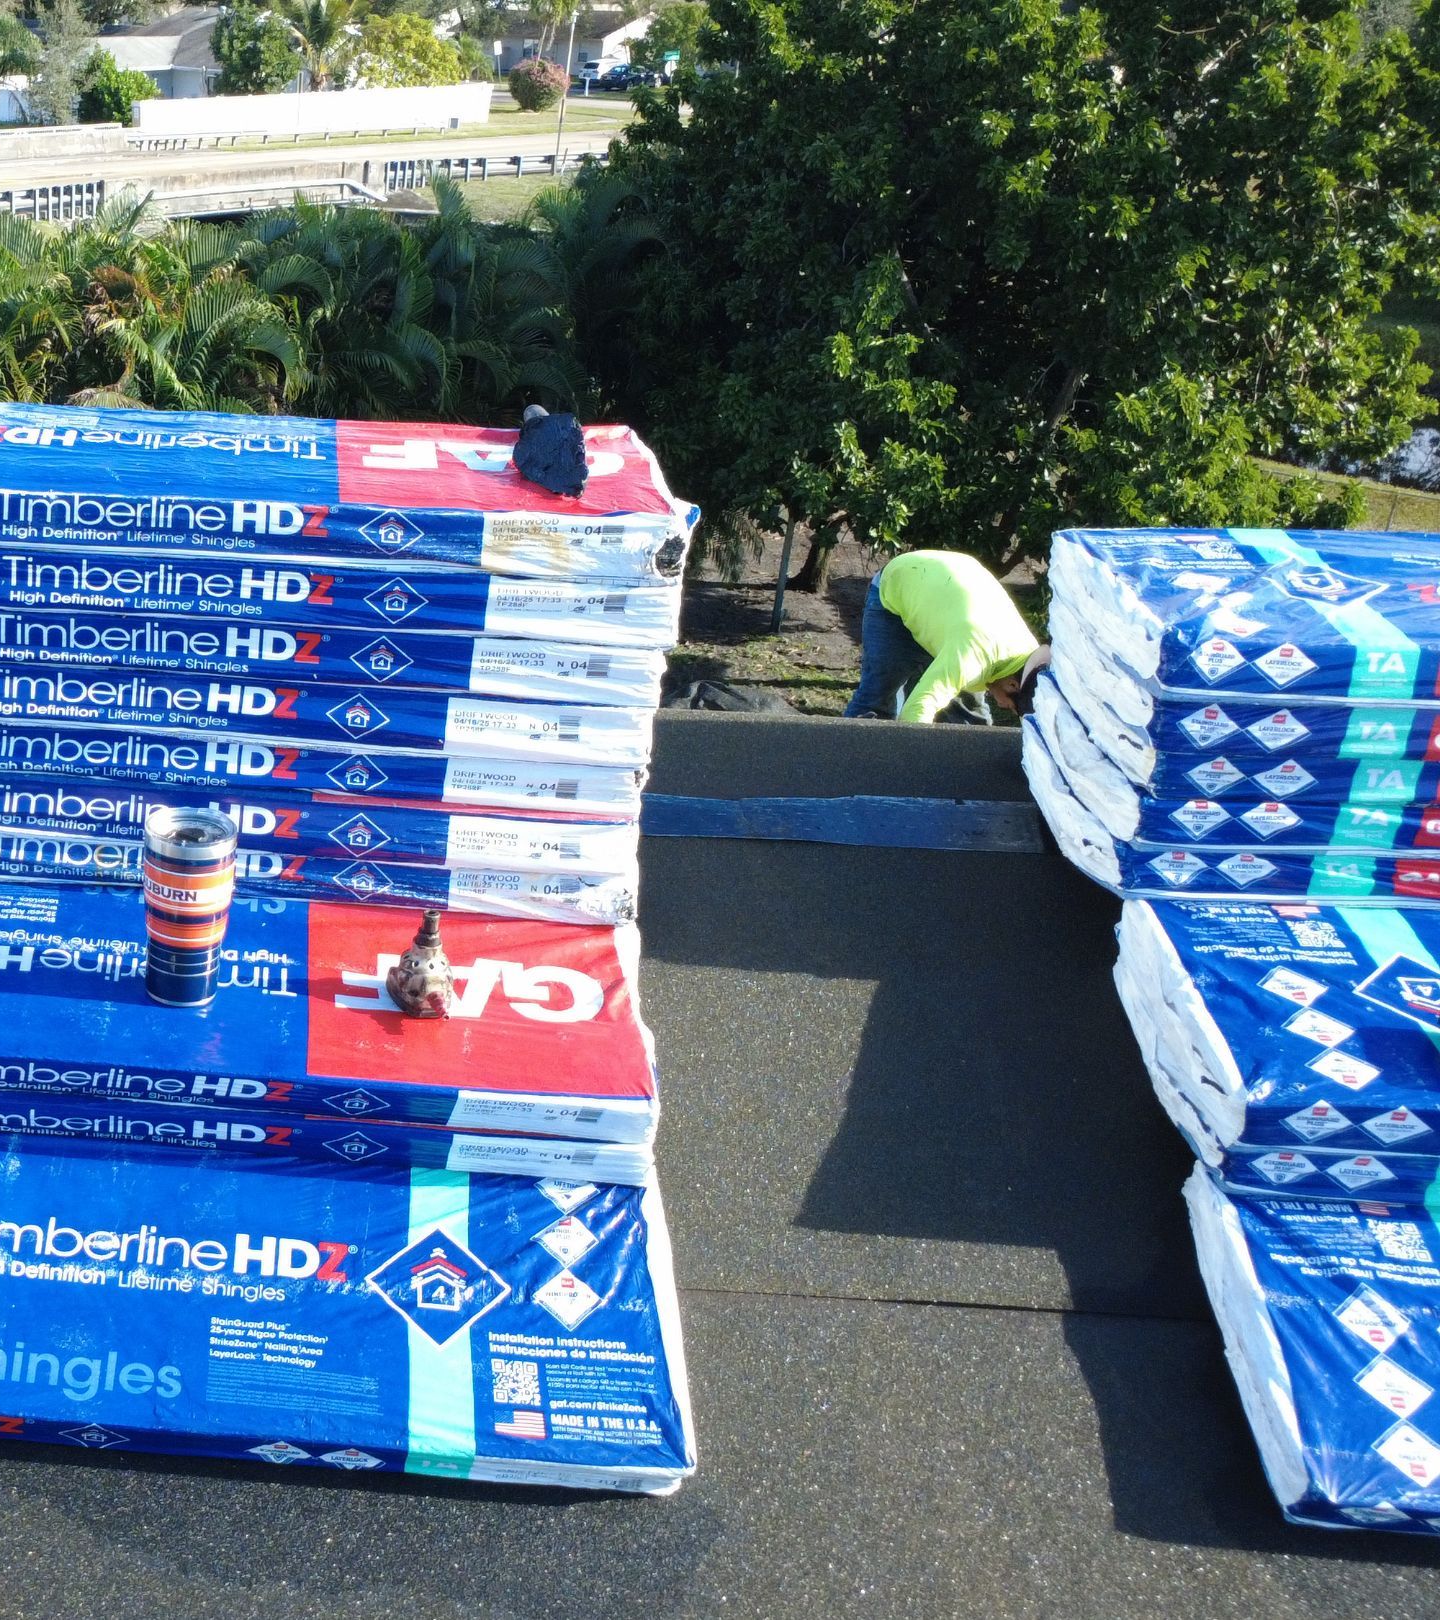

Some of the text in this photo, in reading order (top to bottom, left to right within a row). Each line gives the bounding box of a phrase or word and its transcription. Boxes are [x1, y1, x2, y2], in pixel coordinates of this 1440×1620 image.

[80, 428, 326, 461] Timberline
[0, 492, 225, 531] Timberline
[2, 523, 37, 539] High
[191, 534, 255, 549] Shingles
[584, 525, 602, 536] 04
[2, 555, 233, 598] Timberline
[10, 590, 45, 606] High
[198, 600, 262, 616] Shingles
[587, 596, 605, 606] 04
[0, 647, 35, 663] High
[185, 658, 249, 674] Shingles
[480, 650, 546, 660] DRIFTWOOD
[518, 660, 544, 668] 17:33
[570, 660, 587, 671] 04
[1366, 652, 1407, 674] TA
[168, 712, 228, 728] Shingles
[542, 722, 558, 732] 04
[1360, 721, 1397, 741] TA
[165, 771, 227, 787] Shingles
[453, 770, 517, 781] DRIFTWOOD
[1366, 768, 1407, 790] TA
[540, 782, 556, 792] 04
[1349, 808, 1389, 826] TA
[542, 842, 559, 852] 04
[458, 872, 520, 882] DRIFTWOOD
[144, 875, 197, 902] UBURN
[544, 884, 559, 895] 04
[148, 1091, 215, 1104] Shingles
[560, 1108, 578, 1118] 04
[202, 1278, 286, 1303] Shingles
[210, 1316, 265, 1329] StainGuard
[210, 1325, 246, 1337] 25-year
[247, 1329, 276, 1339] Algae
[488, 1331, 554, 1346] Installation
[264, 1342, 299, 1355] Nailing
[300, 1346, 324, 1356] Area
[489, 1342, 568, 1358] Instrucciones
[570, 1348, 587, 1359] de
[262, 1352, 317, 1368] Technology
[550, 1413, 663, 1432] MADE IN THE U.S.A.
